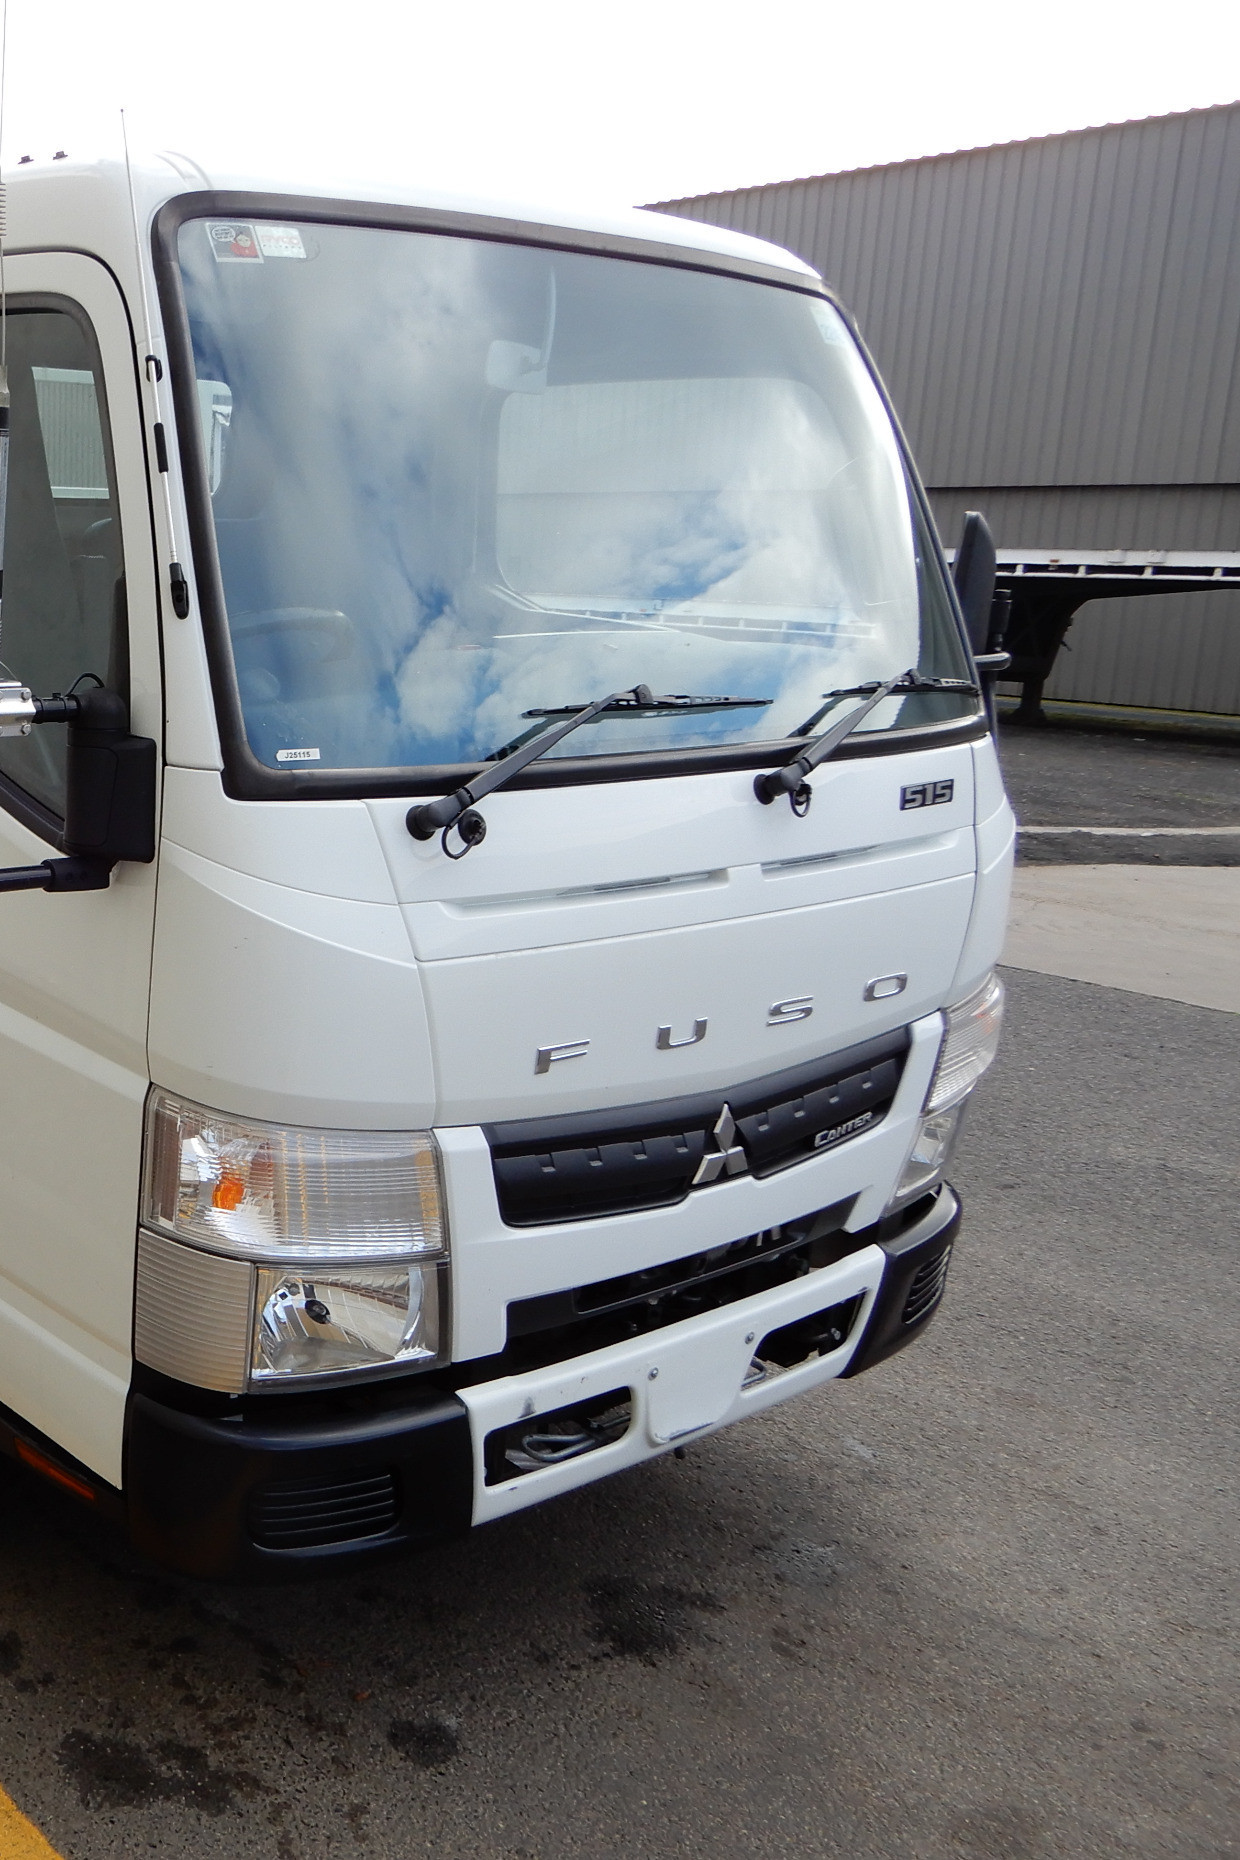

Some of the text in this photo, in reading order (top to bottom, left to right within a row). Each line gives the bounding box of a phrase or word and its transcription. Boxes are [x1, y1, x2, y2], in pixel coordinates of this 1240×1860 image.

[284, 751, 311, 759] J25115
[902, 779, 953, 809] 515
[534, 971, 908, 1075] FUSO
[814, 1111, 873, 1148] CANTER
